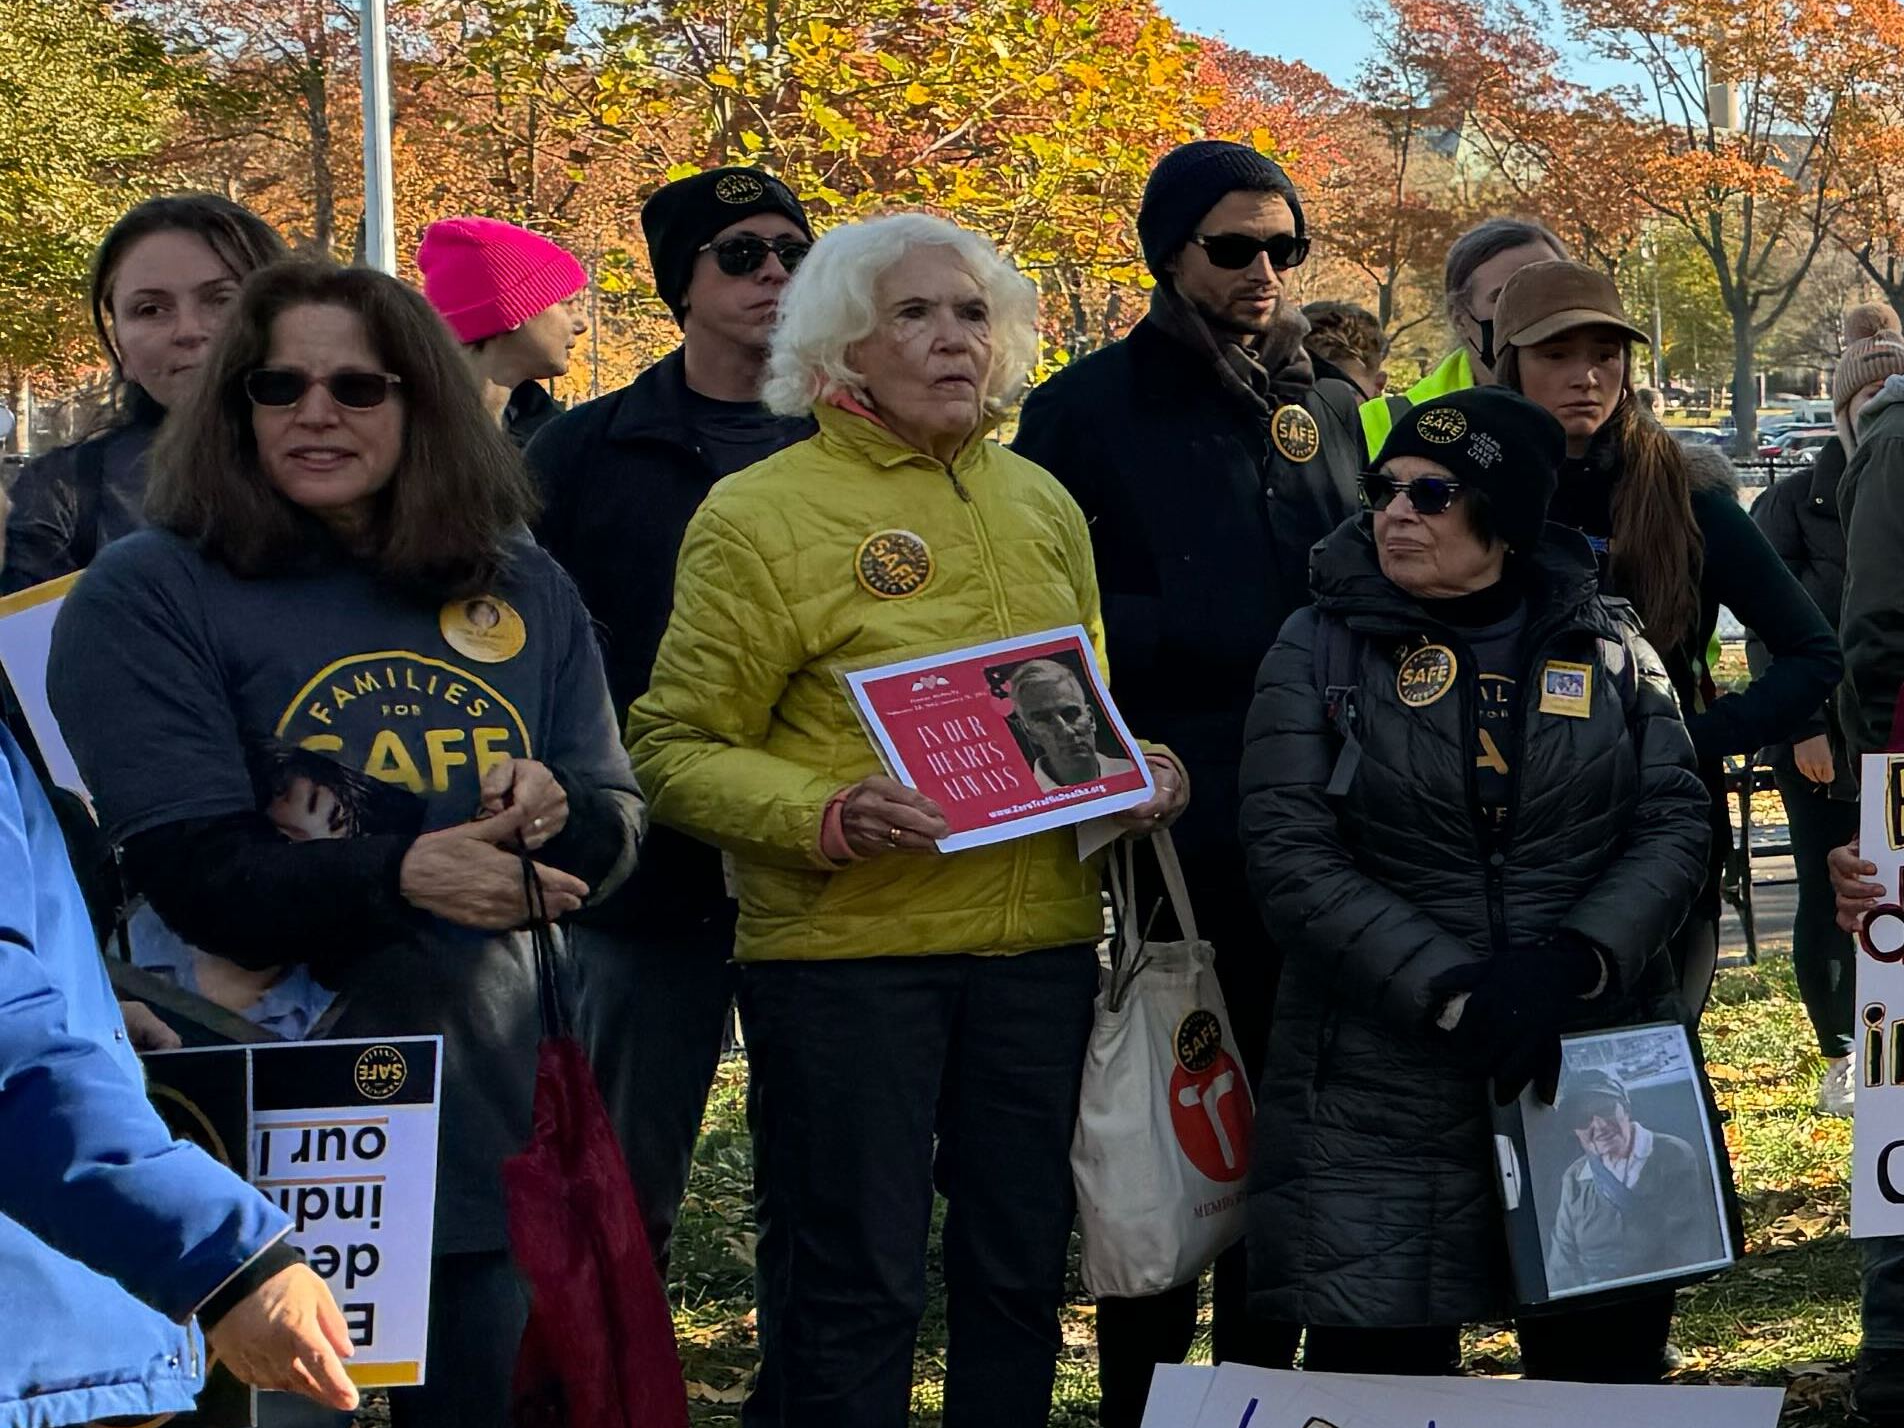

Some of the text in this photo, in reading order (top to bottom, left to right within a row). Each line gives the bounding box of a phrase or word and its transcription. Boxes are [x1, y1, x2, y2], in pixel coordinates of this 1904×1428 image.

[1279, 418, 1315, 445] SAFE
[1420, 413, 1463, 437] SAFE
[869, 538, 921, 590] SAFE
[1402, 664, 1449, 687] SAFE
[309, 666, 491, 725] FAMILIES
[916, 715, 988, 749] IN OUR
[301, 726, 510, 794] AFE
[925, 740, 1006, 777] HEARTS
[942, 765, 1020, 803] ALWAYS
[1180, 1020, 1220, 1064] SAFE
[358, 1063, 403, 1082] SAFE
[289, 1124, 388, 1164] our
